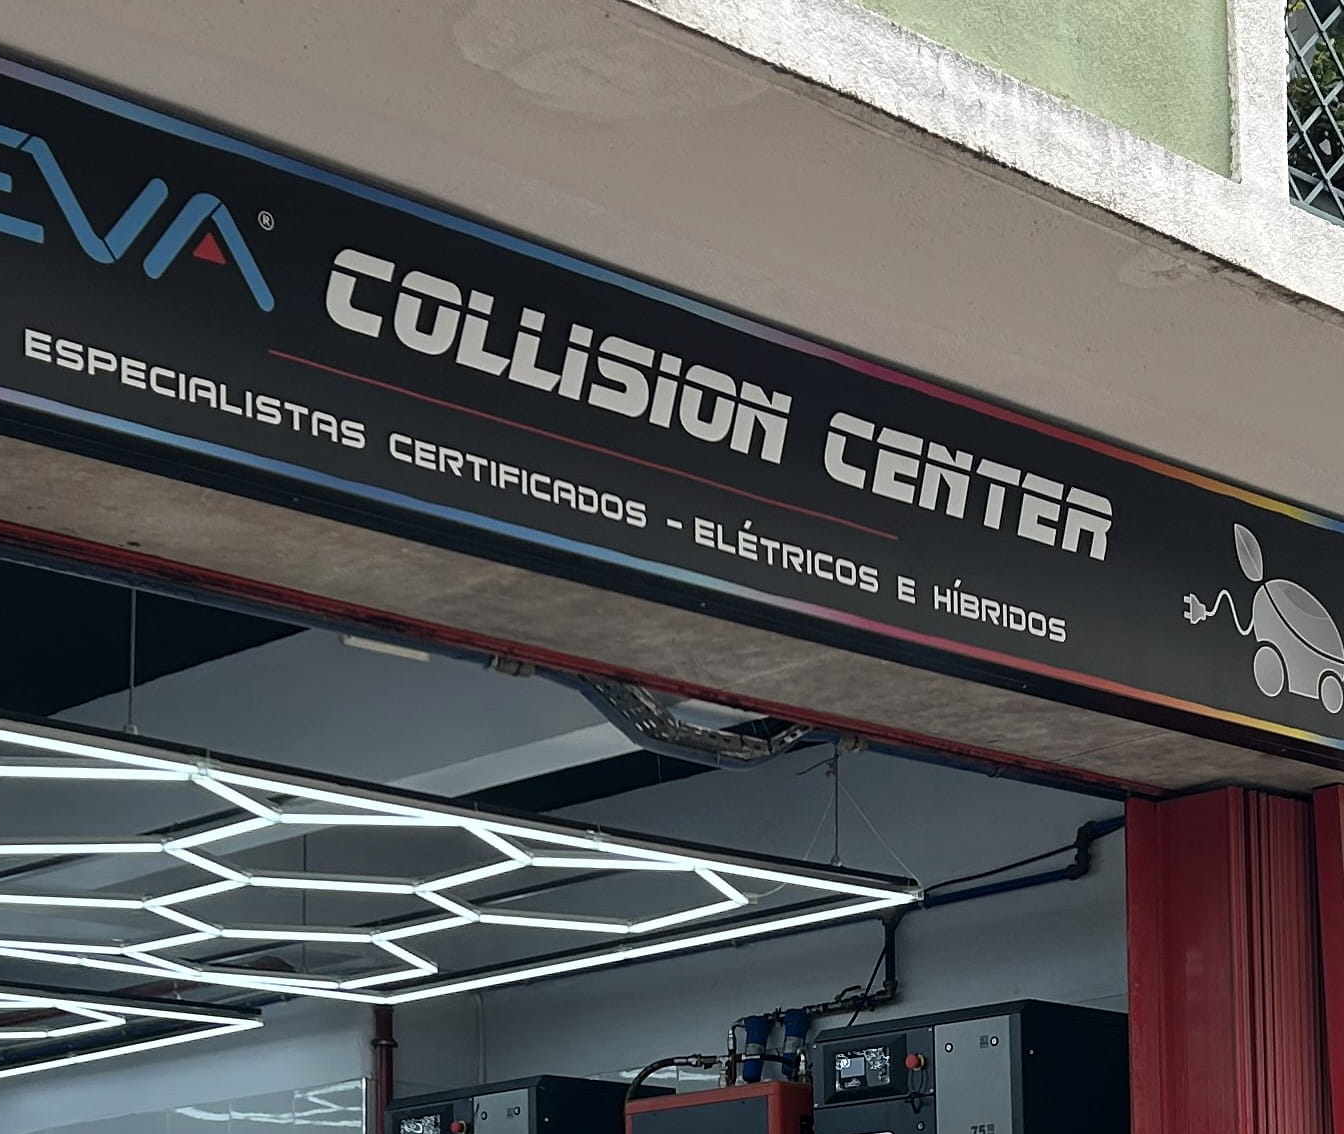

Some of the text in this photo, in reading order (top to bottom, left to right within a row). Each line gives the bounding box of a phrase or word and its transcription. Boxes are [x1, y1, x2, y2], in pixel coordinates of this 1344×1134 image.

[24, 328, 366, 449] ESPECIALISTAS
[388, 432, 647, 528] CERTIFICADOS
[694, 518, 879, 593] ELÉTRICOS
[898, 575, 916, 604] E
[934, 579, 1067, 643] HÍBRIDOS
[325, 248, 1113, 561] COLLISION CENTER
